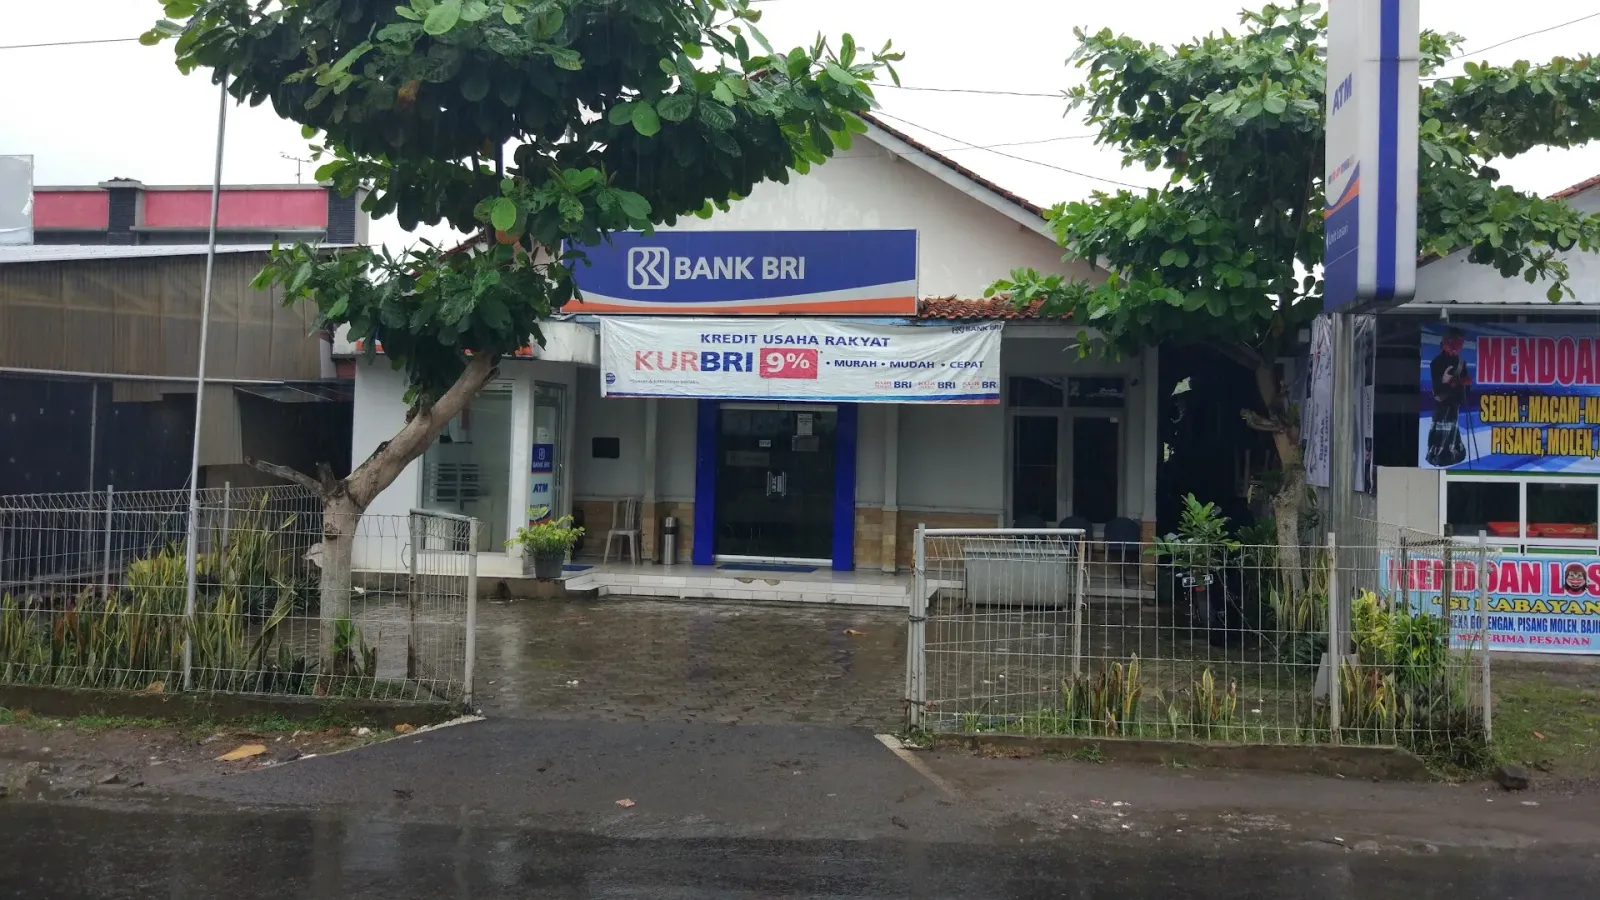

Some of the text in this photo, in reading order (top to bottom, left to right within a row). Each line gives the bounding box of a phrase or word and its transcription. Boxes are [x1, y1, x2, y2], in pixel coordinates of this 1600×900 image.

[1332, 72, 1352, 116] ATM
[674, 256, 806, 280] BANK BRI
[700, 333, 891, 347] KREDIT USAHA RAKYAT
[634, 350, 754, 373] KURBRI
[834, 360, 984, 369] MURAH MUDAH CEPAT
[893, 381, 912, 389] BRI
[937, 381, 956, 389] BRI
[1480, 394, 1519, 423] SEDIA
[1528, 395, 1600, 424] MACAM-M
[1491, 426, 1545, 458] PISANG,
[1547, 427, 1596, 460] MOLEN,
[533, 483, 549, 493] ATM
[1517, 617, 1548, 633] PISANG
[1529, 635, 1591, 646] PESANAN
